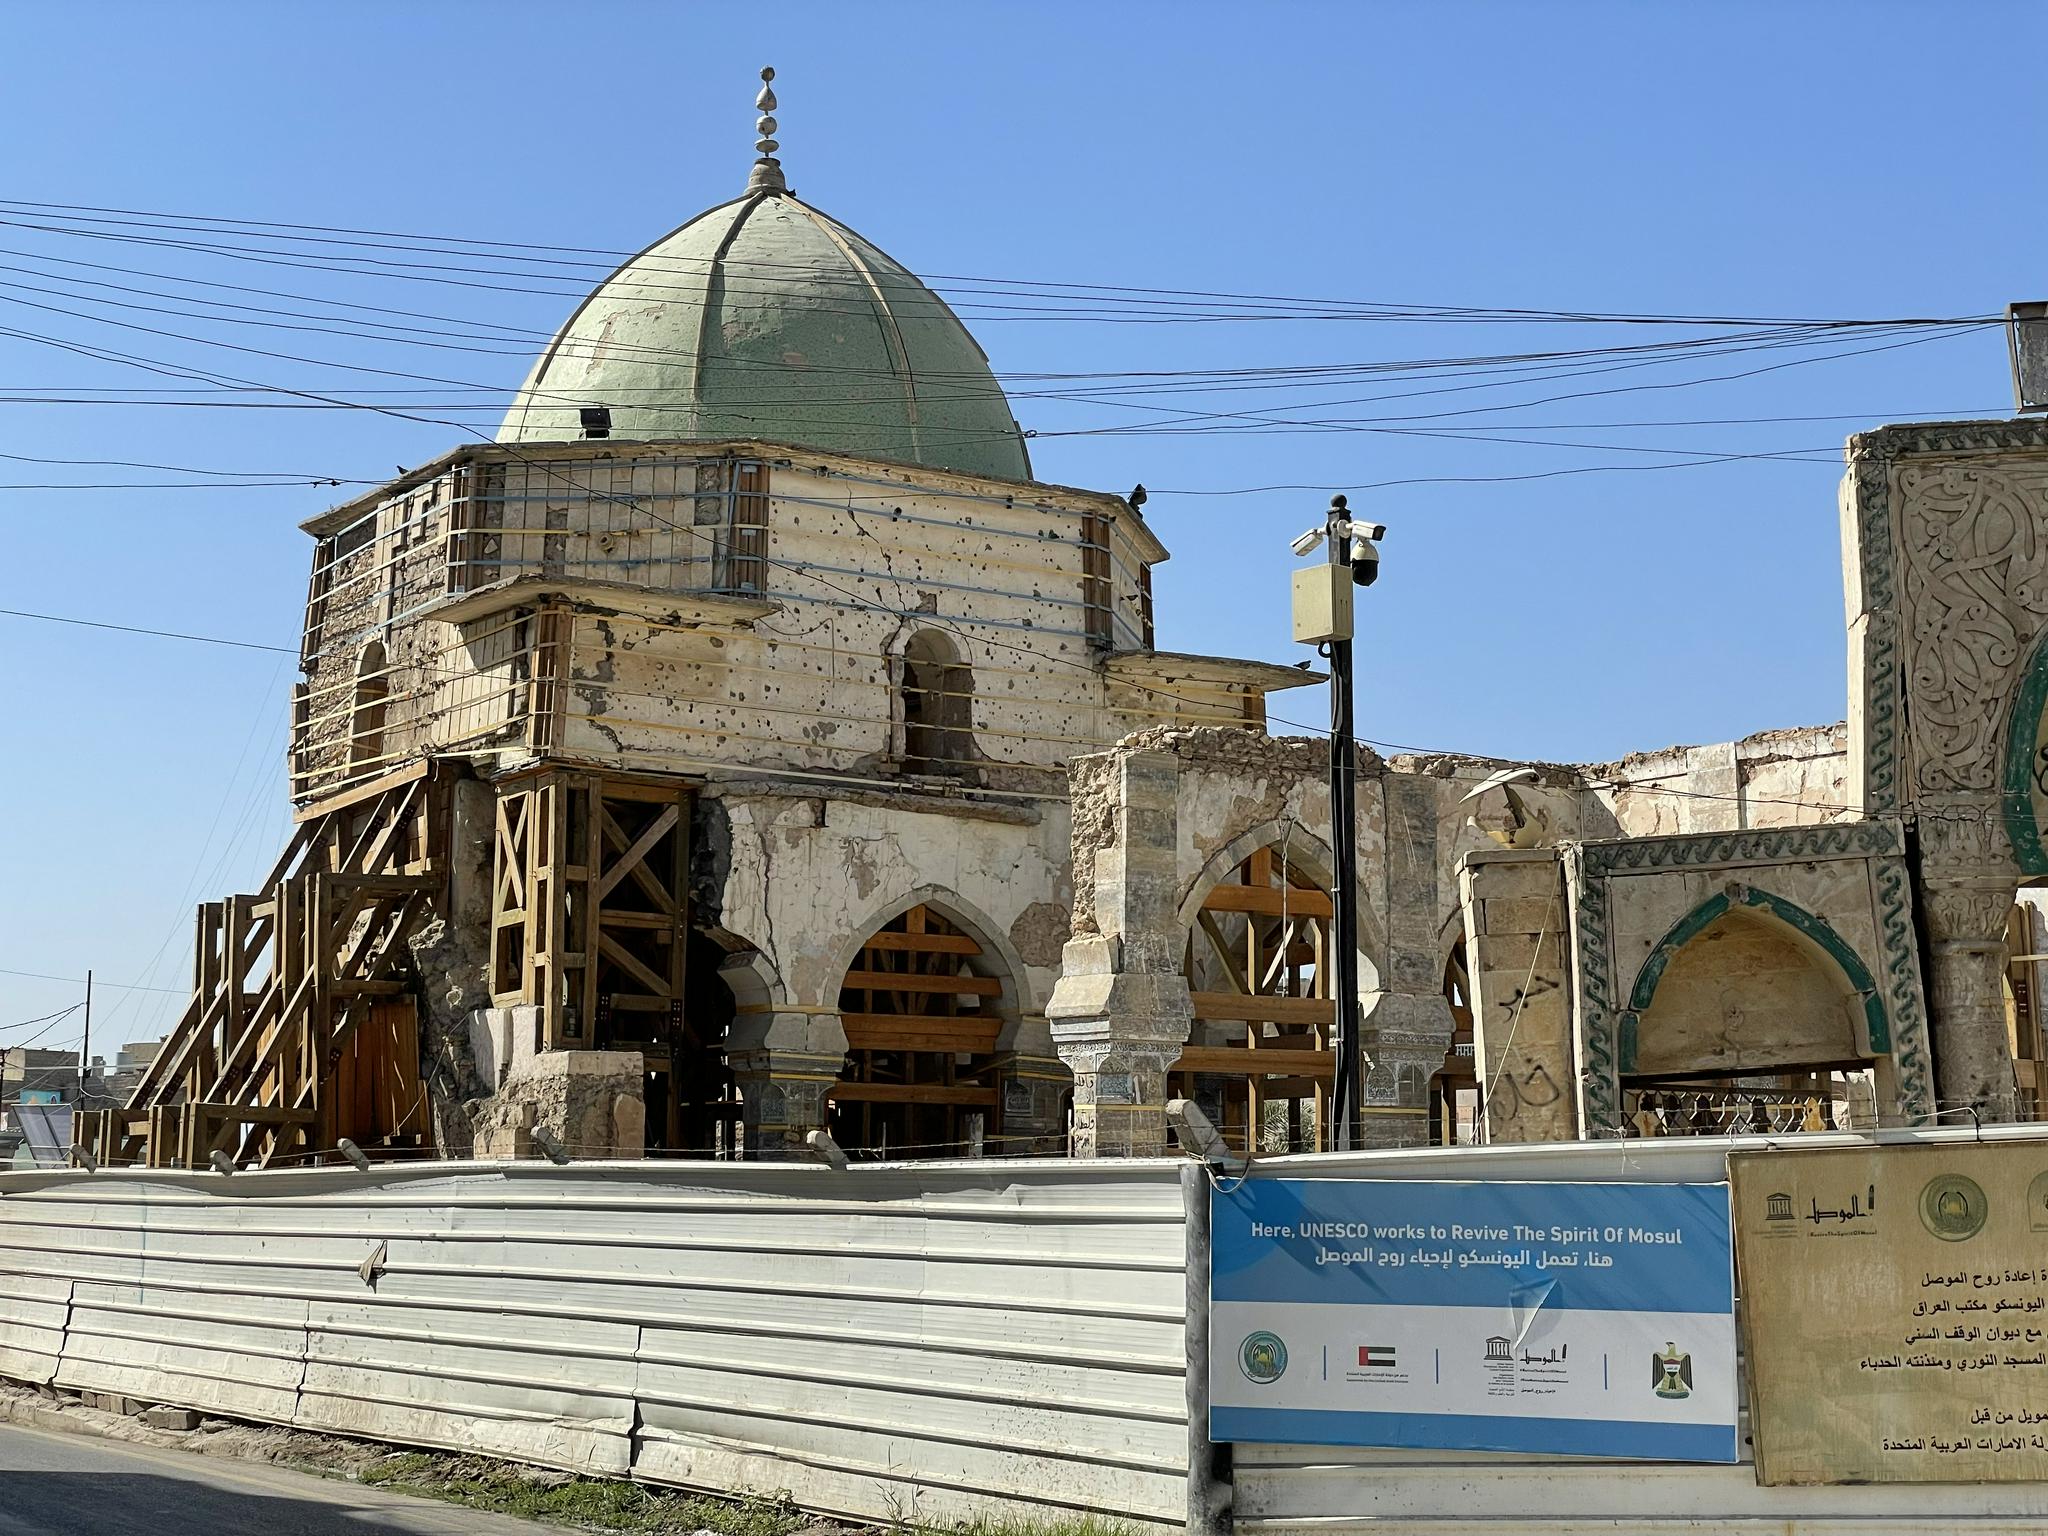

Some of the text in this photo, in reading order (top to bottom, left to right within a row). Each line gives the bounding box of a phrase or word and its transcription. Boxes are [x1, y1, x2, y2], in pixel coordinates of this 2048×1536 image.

[1251, 1222, 1682, 1245] Here, UNESCO works to Revive The Spirit Of Mosul
[1315, 1247, 1613, 1270] هنا، تعمل اليونسكو لإحياء روح الموصل
[1921, 1272, 1968, 1287] الموصل
[1973, 1274, 2000, 1288] روح
[1912, 1297, 2045, 1316] اليونسكو مكتب العراق
[1905, 1325, 2042, 1345] مع ديوان الوقف السني
[1860, 1355, 1901, 1371] الحدباء
[1957, 1353, 1997, 1371] النوري
[2003, 1353, 2046, 1369] المسجد
[1971, 1408, 1991, 1424] قبل
[1995, 1411, 2013, 1424] من
[1883, 1437, 1926, 1451] المتحدة
[1930, 1435, 1972, 1453] العربية
